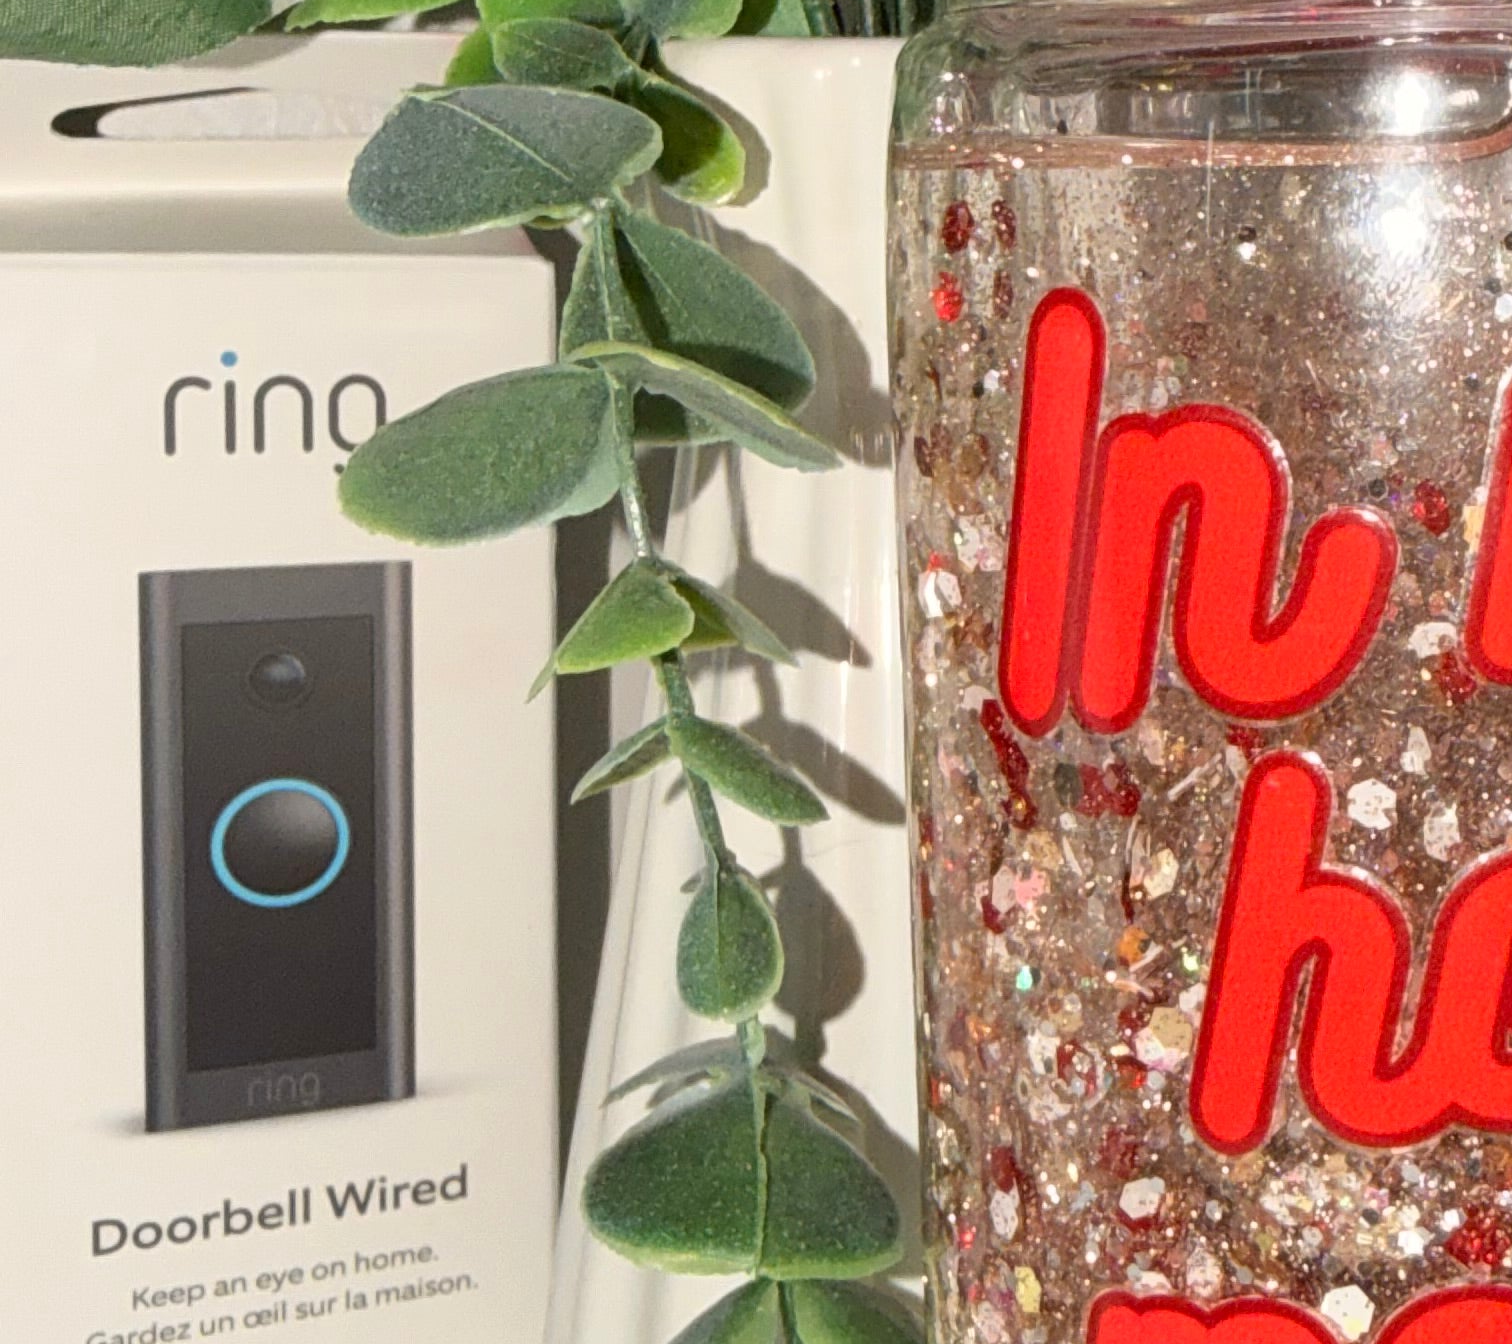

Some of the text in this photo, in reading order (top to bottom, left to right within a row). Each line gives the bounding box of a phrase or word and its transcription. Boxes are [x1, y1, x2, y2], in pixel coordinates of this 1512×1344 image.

[163, 350, 387, 474] ring
[1000, 286, 1397, 736] In
[246, 1069, 322, 1106] ring
[90, 1163, 469, 1257] Doorbell Wired
[131, 1242, 439, 1312] Keep an eye on home.
[199, 1312, 235, 1337] un
[243, 1301, 288, 1330] œil
[295, 1296, 338, 1321] sur
[345, 1280, 369, 1312] la
[374, 1268, 480, 1306] maison.
